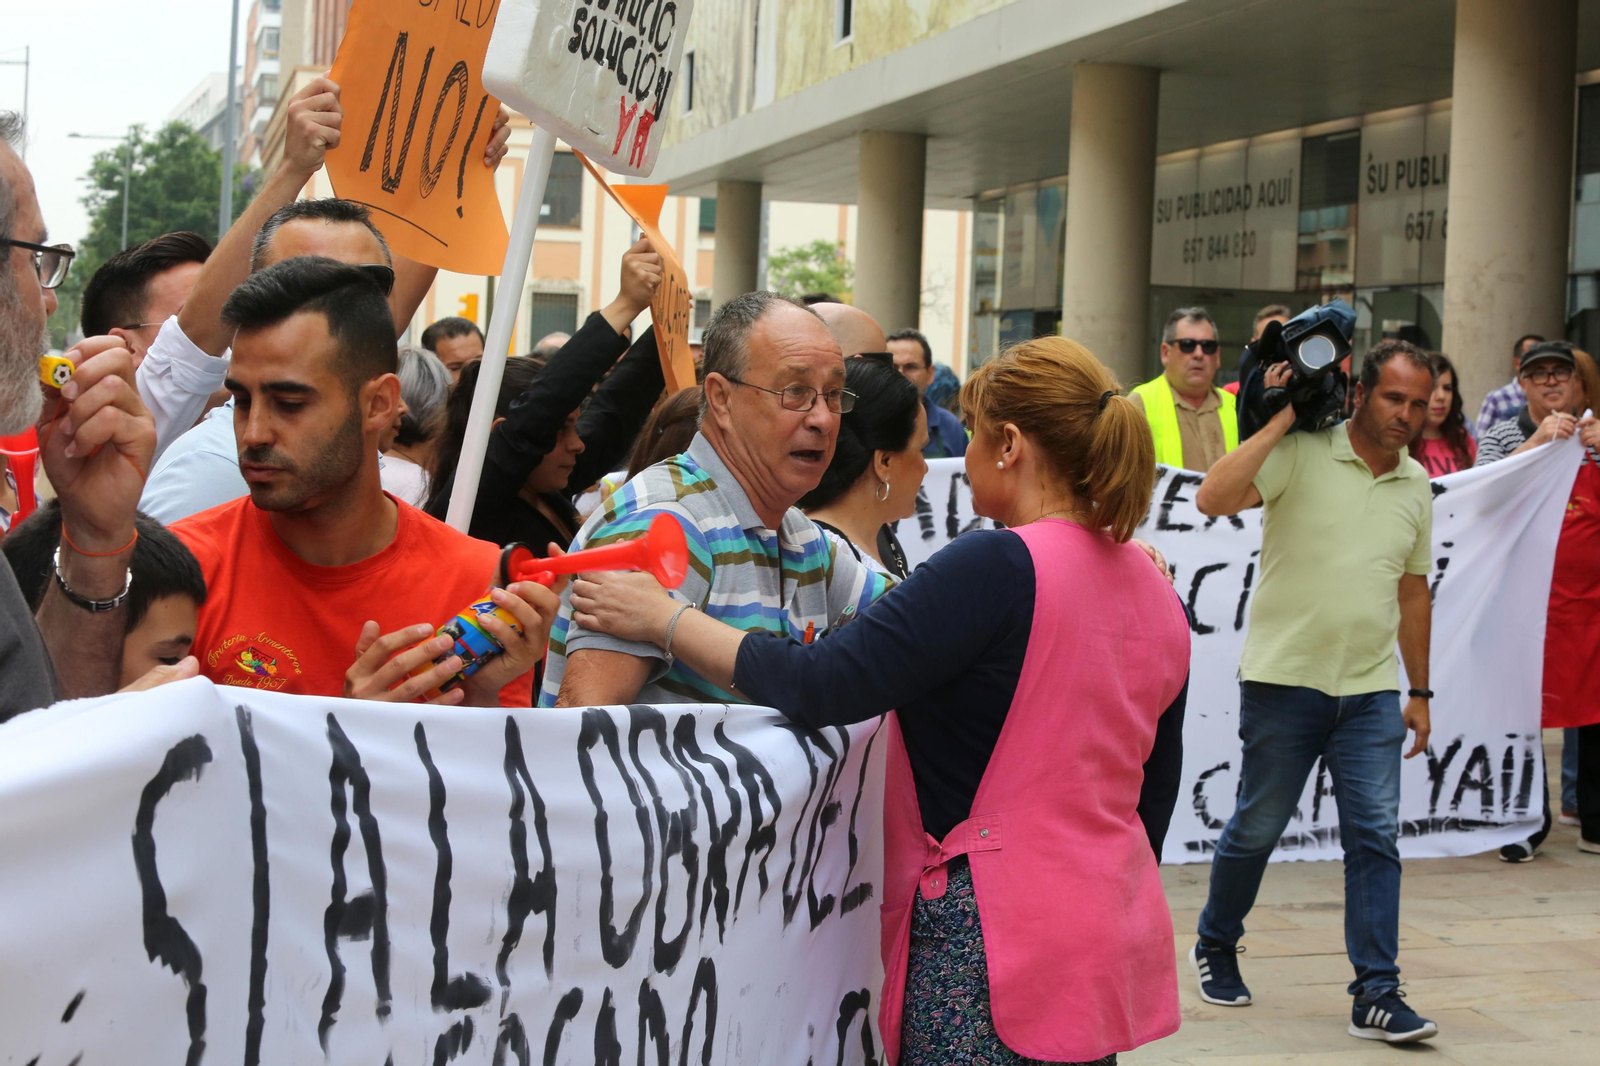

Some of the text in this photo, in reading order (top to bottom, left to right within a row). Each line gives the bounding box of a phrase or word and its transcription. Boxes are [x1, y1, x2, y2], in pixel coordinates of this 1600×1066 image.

[360, 31, 489, 218] NO!
[612, 95, 658, 169] YA
[1156, 168, 1294, 224] SU PUBLICIDAD AQUÍ
[1405, 210, 1434, 242] 657
[222, 674, 254, 687] Desde
